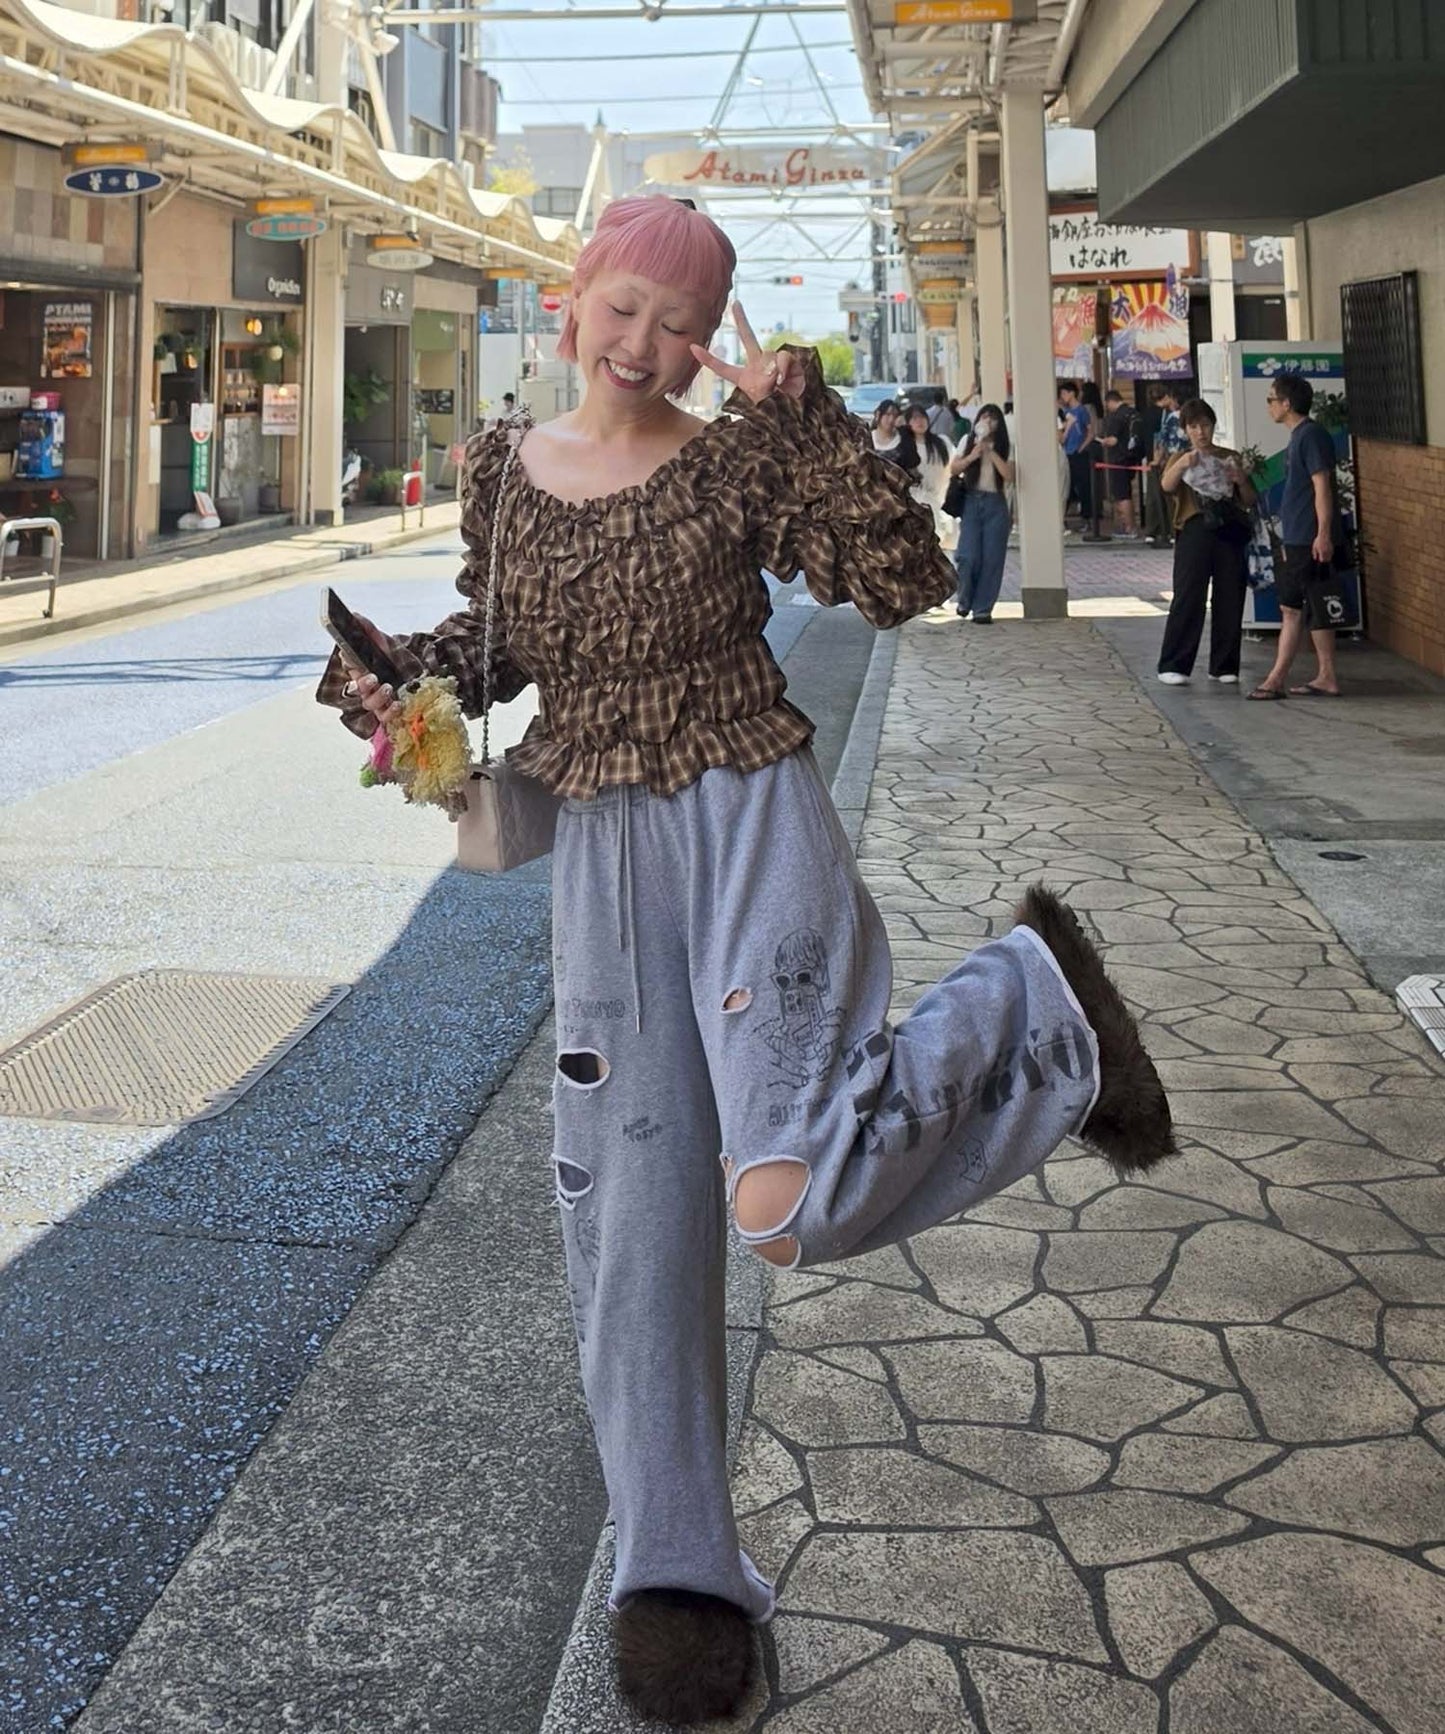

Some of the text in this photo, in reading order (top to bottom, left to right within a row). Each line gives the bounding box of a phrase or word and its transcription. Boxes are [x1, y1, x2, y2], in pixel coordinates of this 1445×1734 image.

[684, 148, 867, 185] Atami Ginza
[1069, 245, 1133, 269] はなれ
[45, 304, 92, 316] ATAMI
[1284, 359, 1330, 372] 伊藤園
